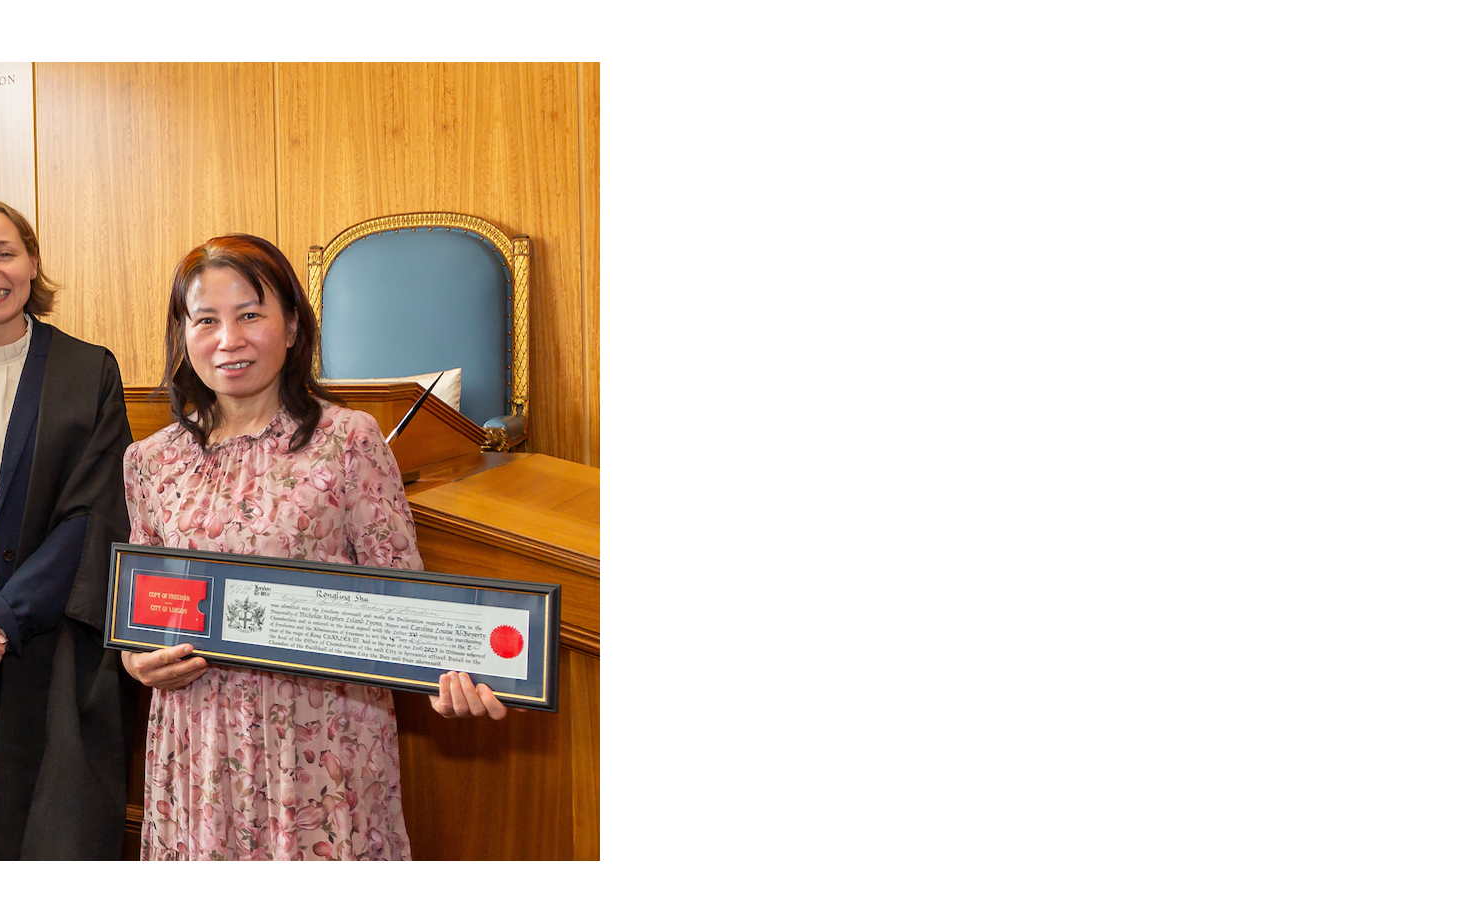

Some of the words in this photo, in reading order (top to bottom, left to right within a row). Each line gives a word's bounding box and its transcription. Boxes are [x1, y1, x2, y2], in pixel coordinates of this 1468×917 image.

[169, 593, 190, 601] FREEDOM
[316, 590, 350, 601] Rongling
[354, 594, 368, 602] Shu
[169, 606, 188, 614] LONDON
[411, 624, 433, 632] Caroline
